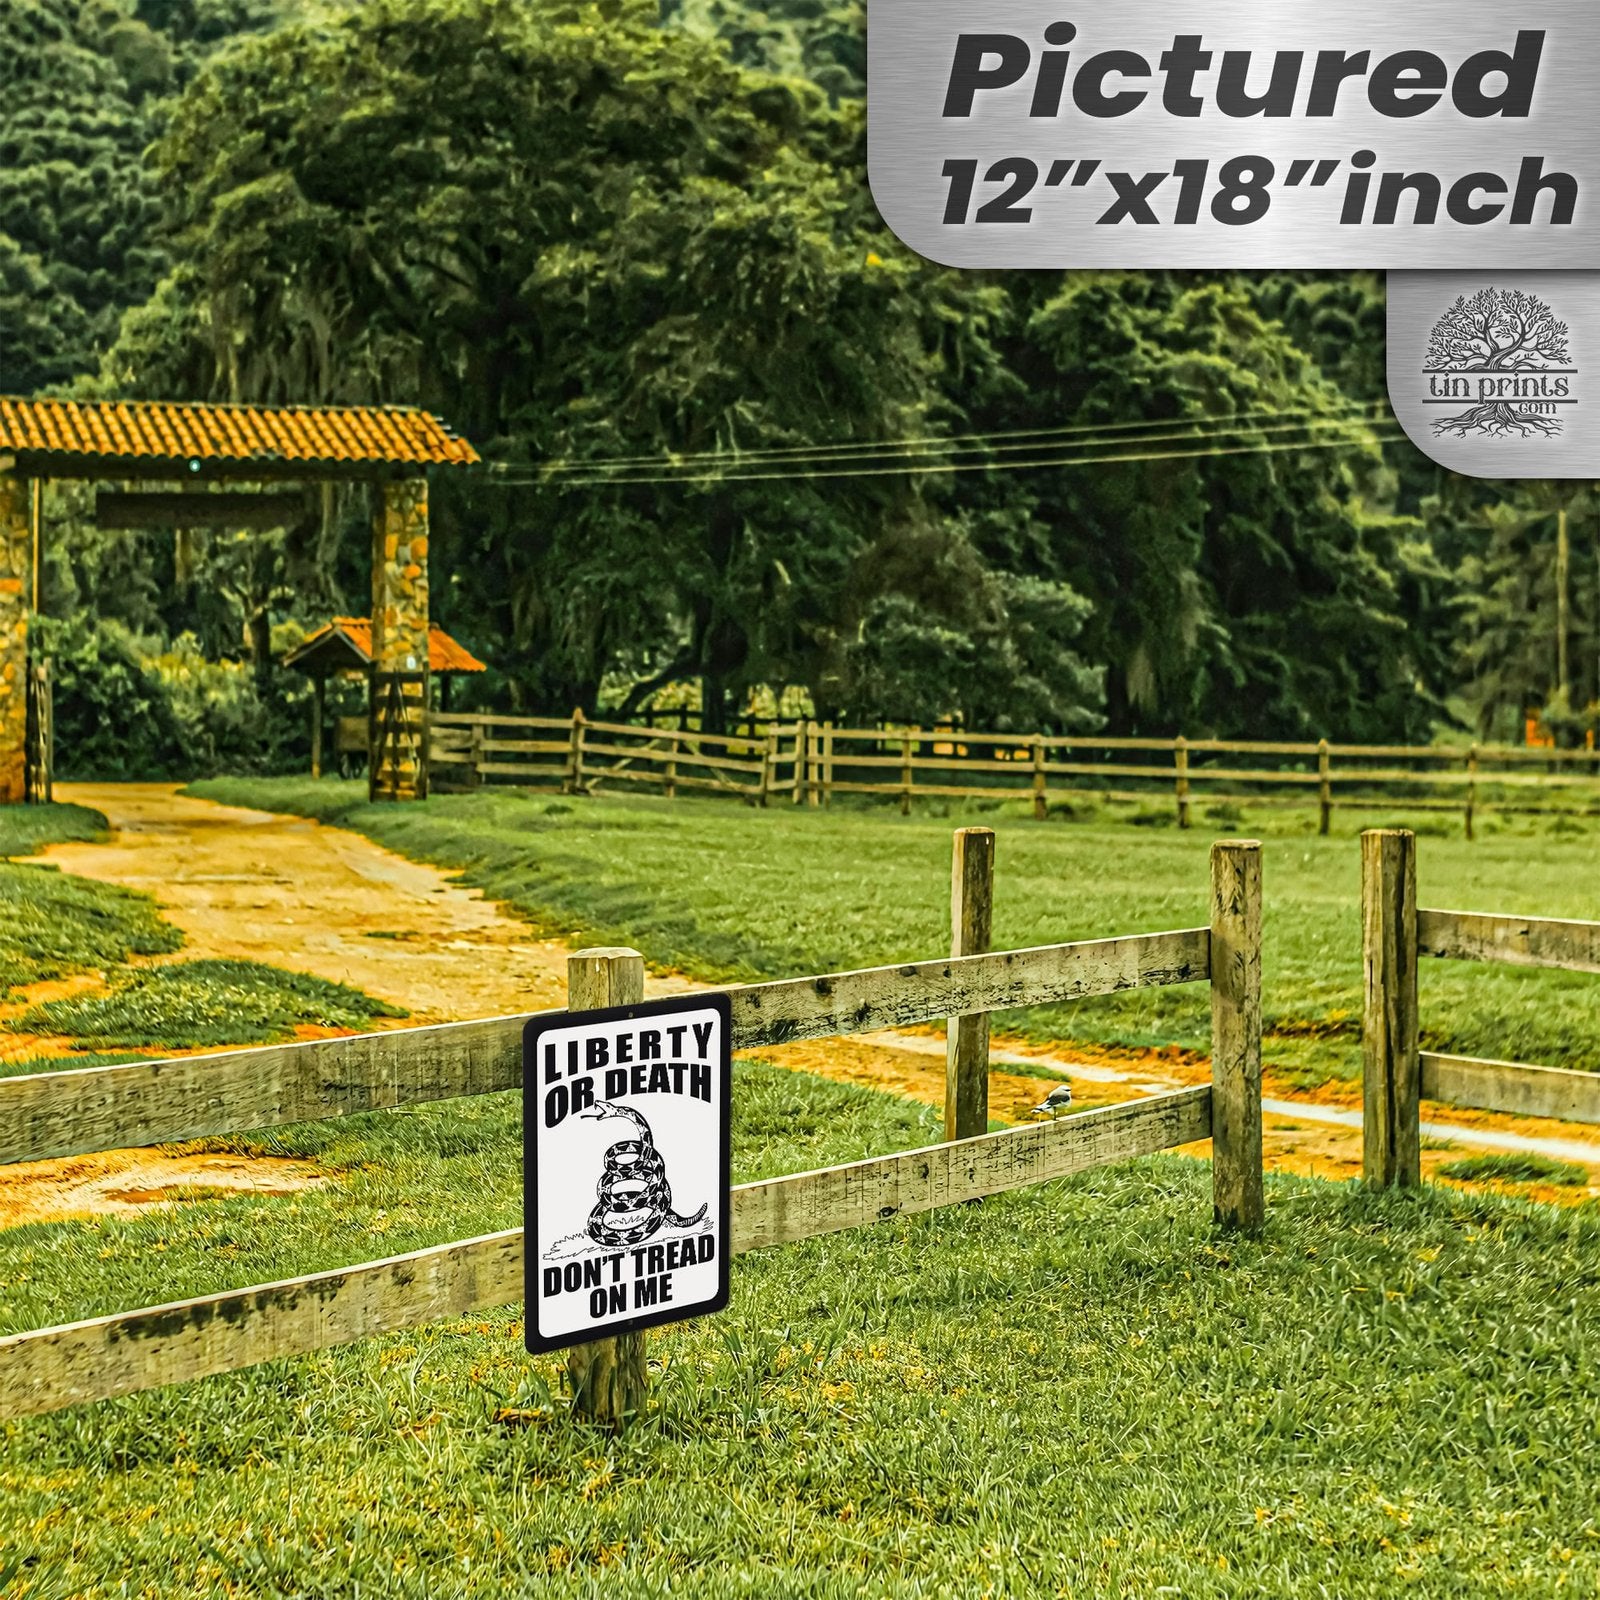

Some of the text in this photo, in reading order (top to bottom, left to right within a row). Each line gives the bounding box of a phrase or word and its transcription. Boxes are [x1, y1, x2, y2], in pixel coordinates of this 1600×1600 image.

[544, 1021, 714, 1086] LIBERTY
[545, 1062, 711, 1128] OR DEATH
[543, 1234, 715, 1298] DON'T TREAD
[589, 1273, 673, 1318] ON ME
